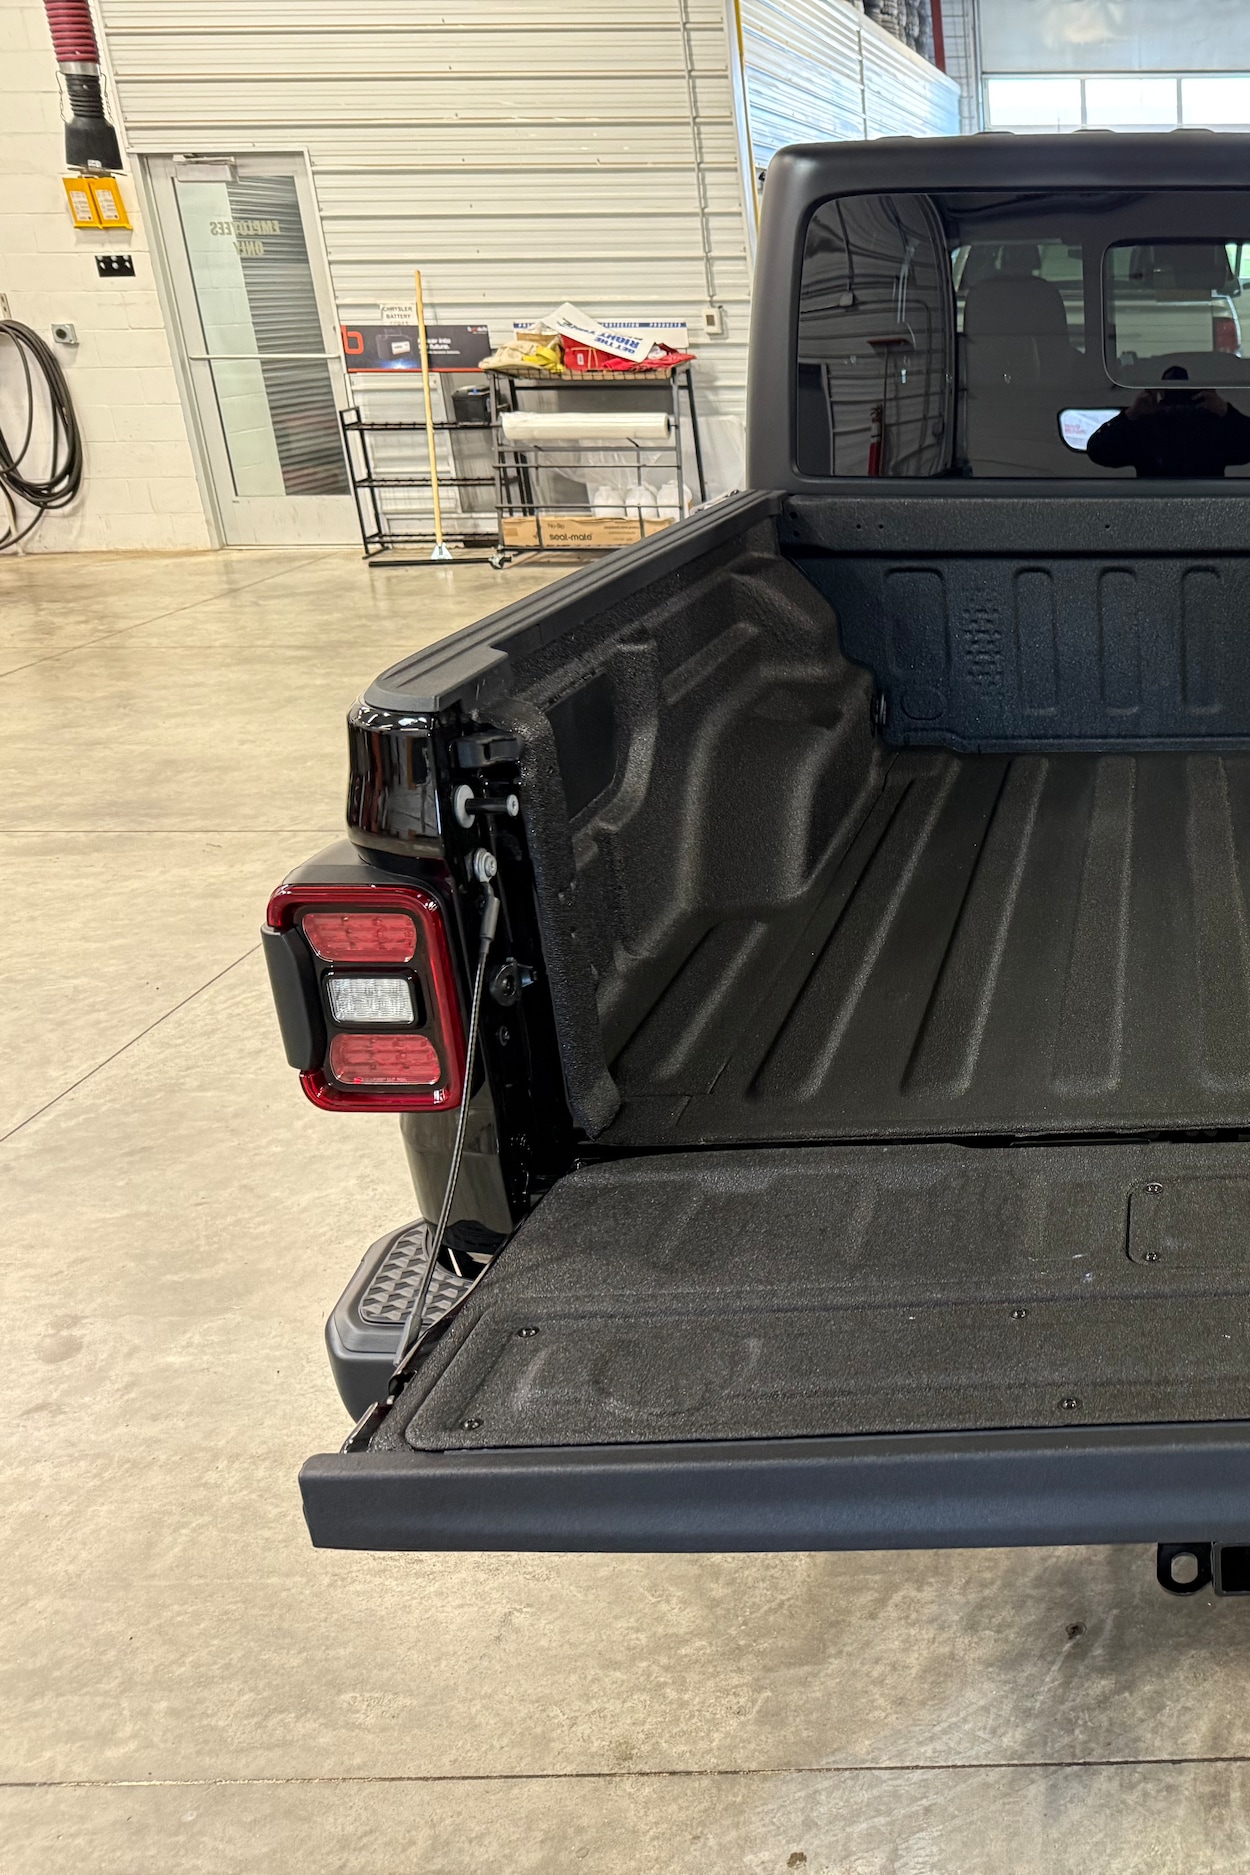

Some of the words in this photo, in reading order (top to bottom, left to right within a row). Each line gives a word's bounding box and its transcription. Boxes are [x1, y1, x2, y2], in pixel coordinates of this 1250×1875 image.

[594, 337, 614, 349] THE
[598, 333, 640, 349] RIGHT
[617, 344, 635, 354] GET
